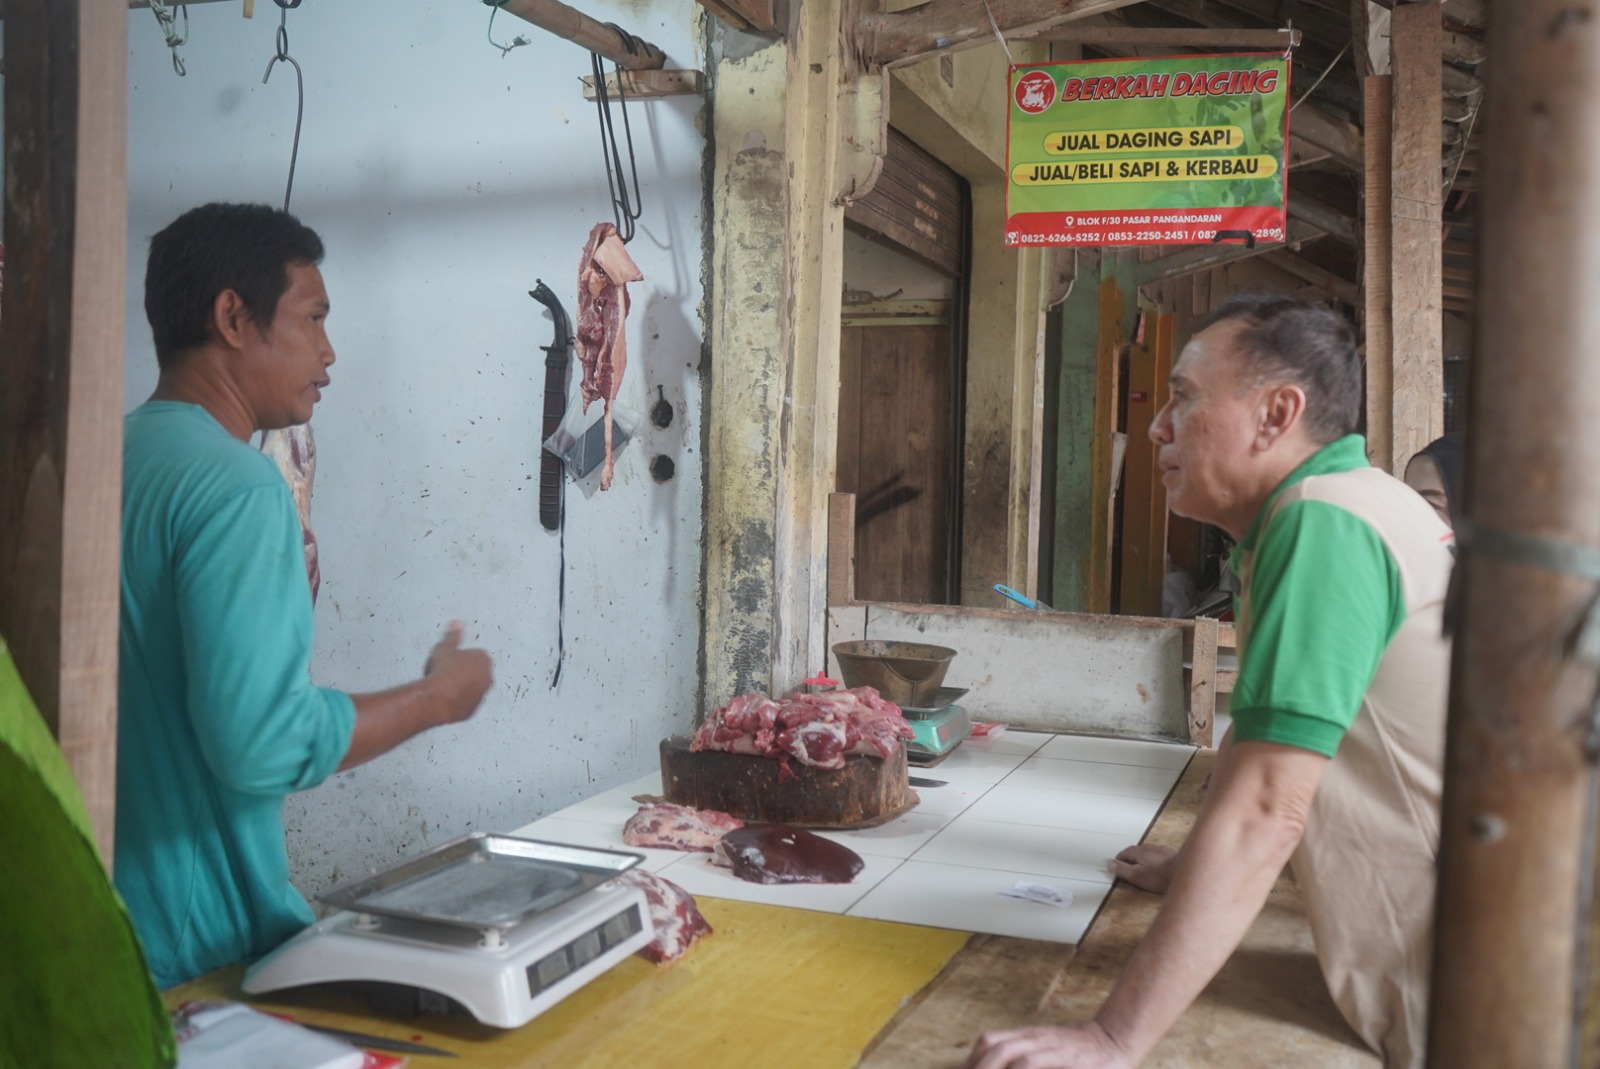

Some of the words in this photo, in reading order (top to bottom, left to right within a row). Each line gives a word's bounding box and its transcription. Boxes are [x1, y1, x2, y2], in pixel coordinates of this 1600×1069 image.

[1061, 74, 1170, 102] BERKAH
[1170, 69, 1279, 97] DAGING
[1056, 132, 1100, 151] JUAL
[1106, 131, 1183, 150] DAGING
[1189, 129, 1231, 146] SAPI
[1029, 160, 1113, 182] JUAL/BELI
[1119, 160, 1160, 178] SAPI
[1166, 159, 1180, 177] &
[1186, 158, 1259, 176] KERBAU
[1077, 215, 1101, 226] BLOK
[1102, 215, 1121, 226] F/30
[1123, 214, 1151, 225] PASAR
[1153, 213, 1222, 225] PANGANDARAN
[1021, 232, 1100, 243] 0822-6266-5252
[1107, 231, 1189, 242] 0853-2250-2451
